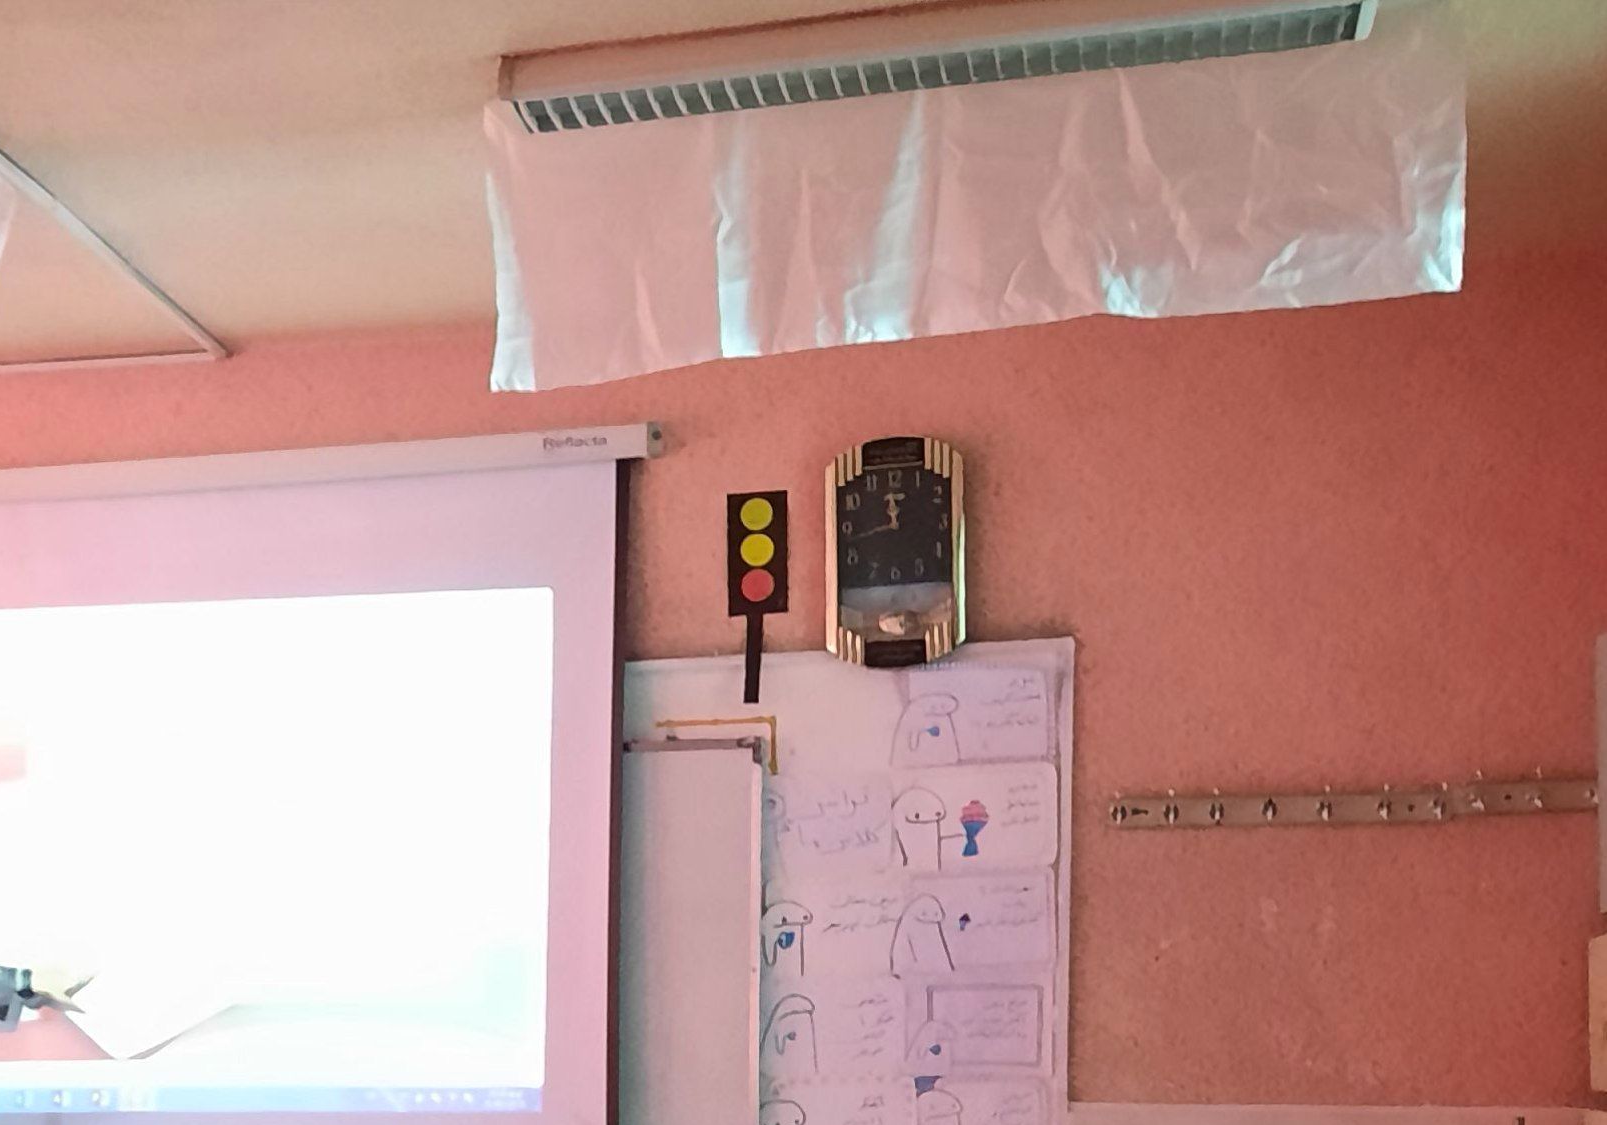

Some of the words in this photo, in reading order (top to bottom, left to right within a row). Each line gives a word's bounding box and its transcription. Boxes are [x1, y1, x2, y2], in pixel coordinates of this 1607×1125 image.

[866, 474, 877, 492] 11
[888, 469, 902, 488] 12
[845, 493, 860, 511] 10
[932, 486, 942, 503] 2
[842, 521, 853, 536] 9
[890, 566, 901, 581] 6
